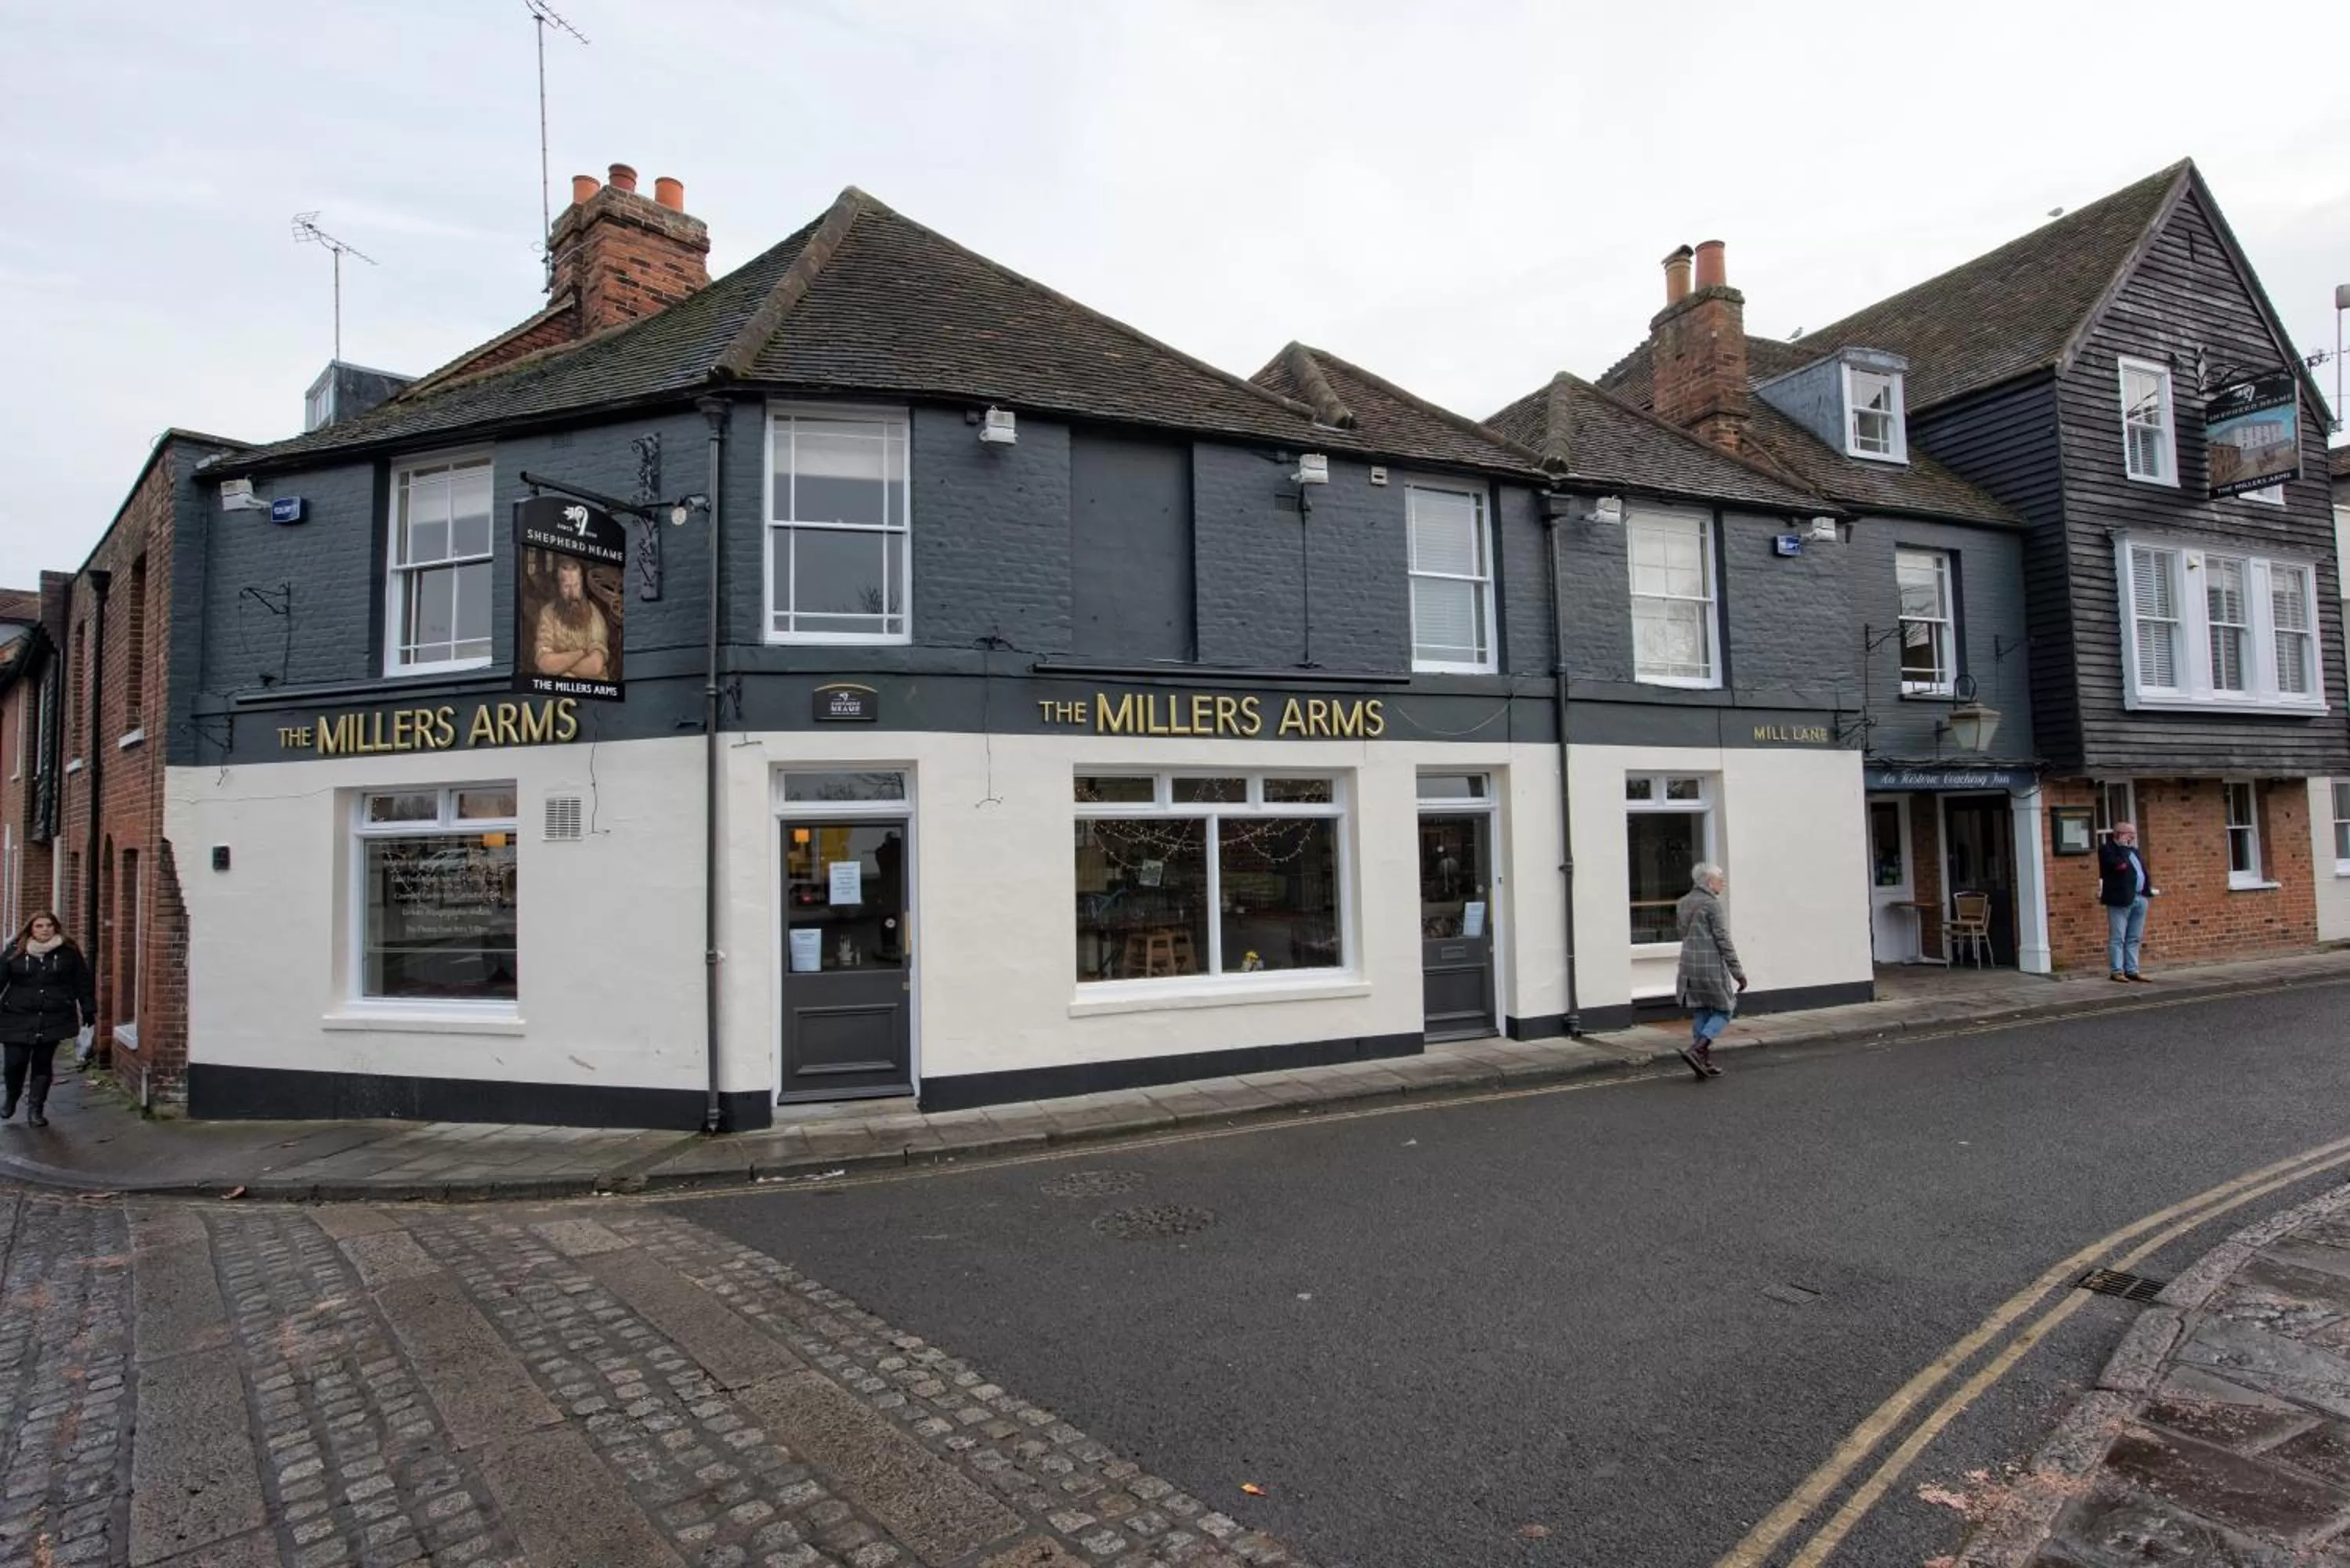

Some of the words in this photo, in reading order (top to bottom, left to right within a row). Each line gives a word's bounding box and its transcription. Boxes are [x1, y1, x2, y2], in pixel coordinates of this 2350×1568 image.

[527, 529, 586, 551] SHEPHERD
[588, 544, 624, 562] NEAME
[533, 679, 552, 690] THE
[555, 681, 591, 693] MILLERS
[593, 685, 618, 696] ARMS
[277, 726, 312, 748] THE
[316, 706, 456, 755] MILLERS
[468, 698, 578, 745] ARMS
[1039, 701, 1087, 723] THE
[1097, 693, 1262, 735] MILLERS
[1278, 698, 1384, 737] ARMS
[1754, 726, 1788, 740] MILL
[1793, 726, 1828, 742] LANE
[1943, 771, 1987, 786] Coaching
[1992, 772, 2010, 785] Inn
